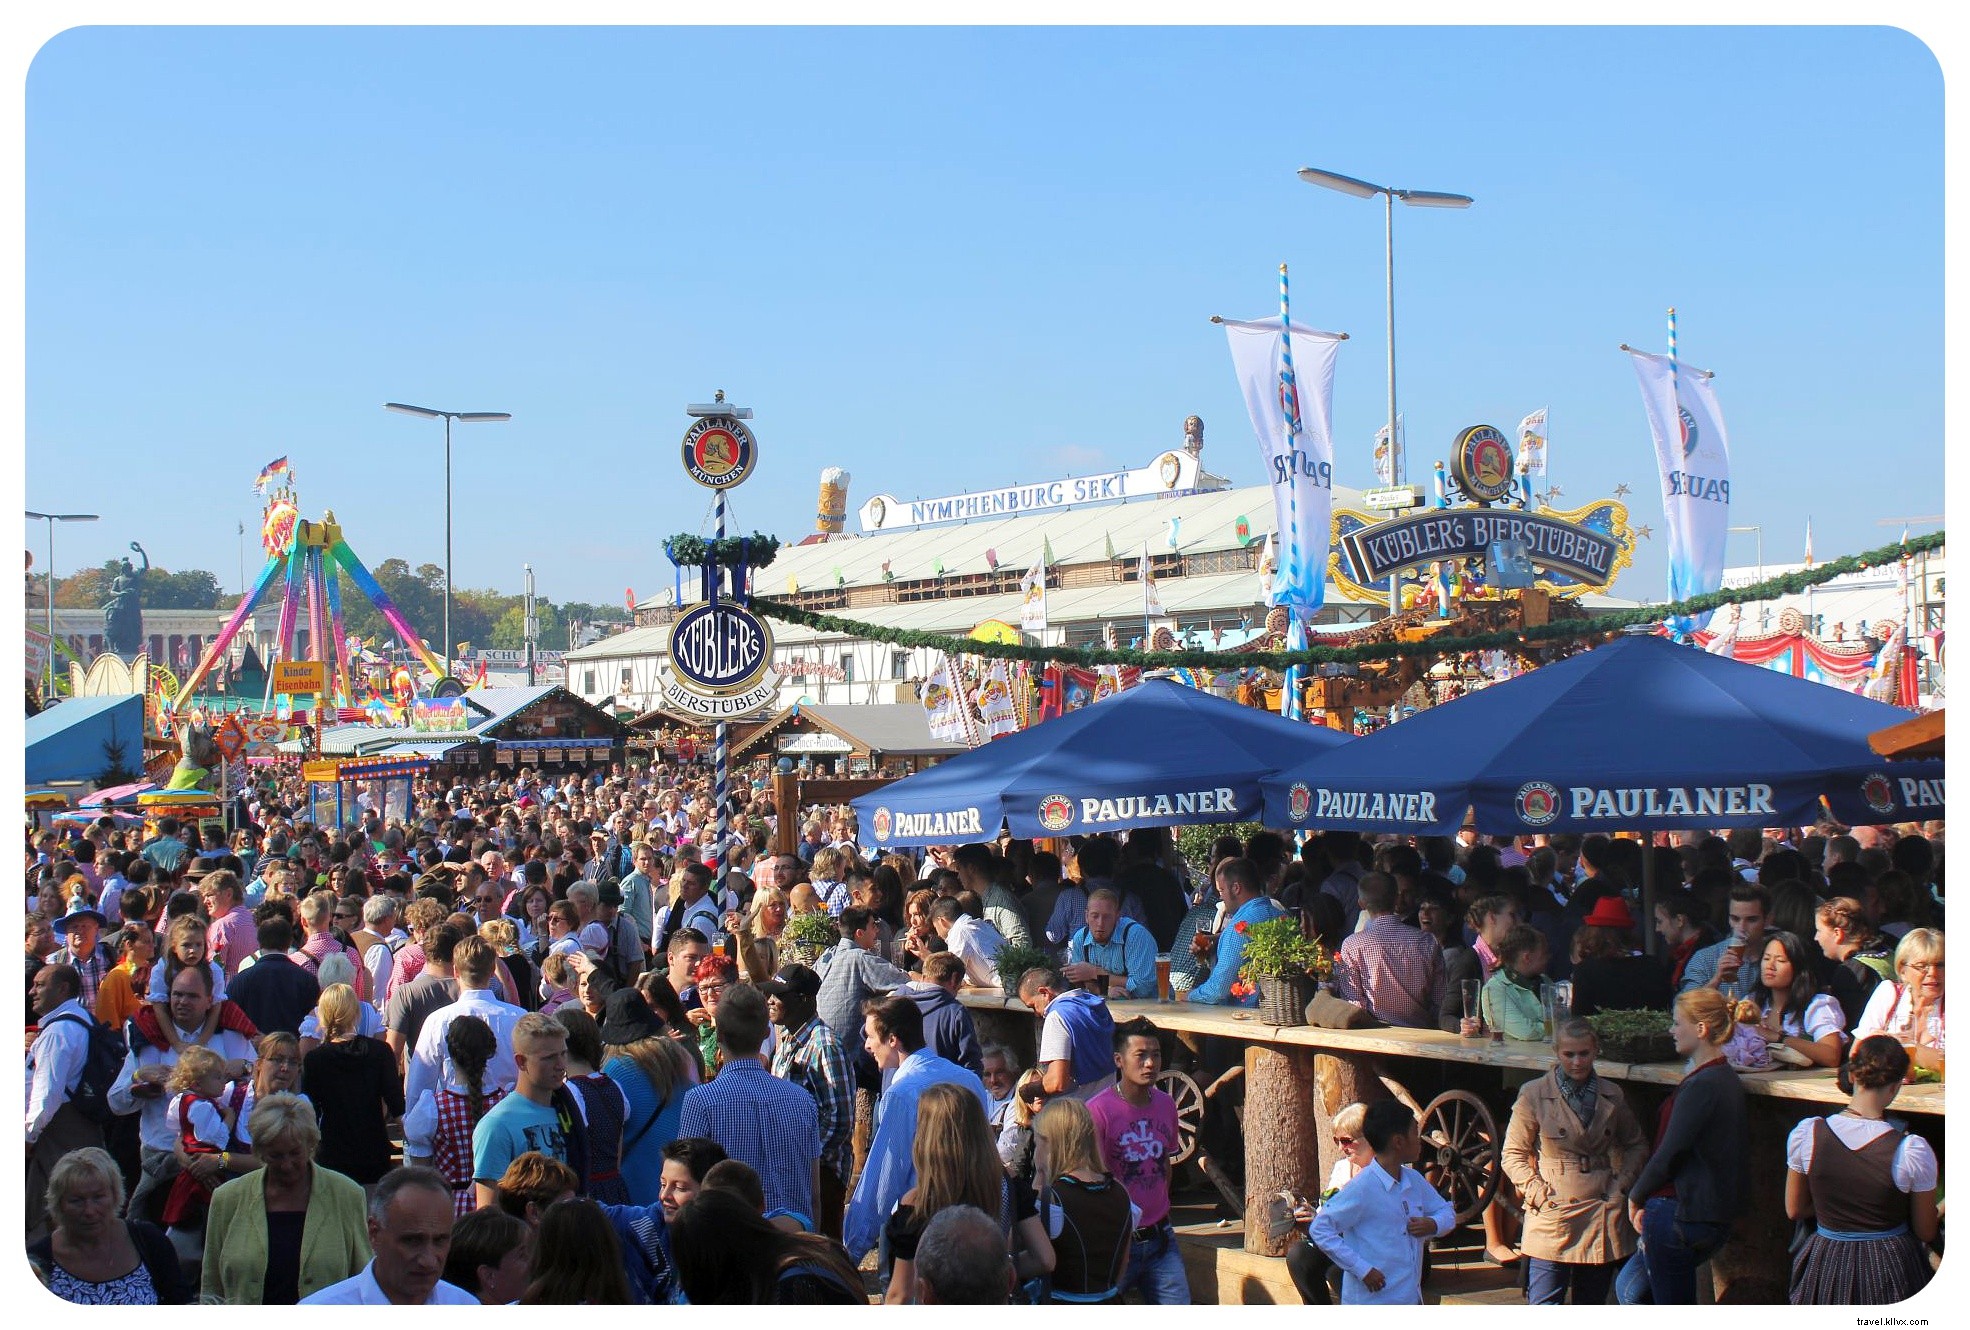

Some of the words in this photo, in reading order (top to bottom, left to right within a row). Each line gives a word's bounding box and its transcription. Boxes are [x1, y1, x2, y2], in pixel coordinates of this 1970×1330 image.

[686, 418, 748, 448] PAULANER
[1466, 430, 1512, 457] PAULANER
[690, 465, 744, 484] MÜNCHEN
[910, 482, 1063, 523] NYMPHENBURG
[1074, 472, 1129, 500] SEKT
[1472, 517, 1608, 574] BIERSTÜBERL
[276, 679, 320, 691] Eisenbahn
[284, 666, 313, 677] Kinder
[668, 684, 771, 714] BIERSTÜBERL
[1081, 787, 1238, 824] PAULANER
[1315, 788, 1439, 823] PAULANER
[1570, 783, 1779, 819] PAULANER
[894, 807, 984, 837] PAULANER
